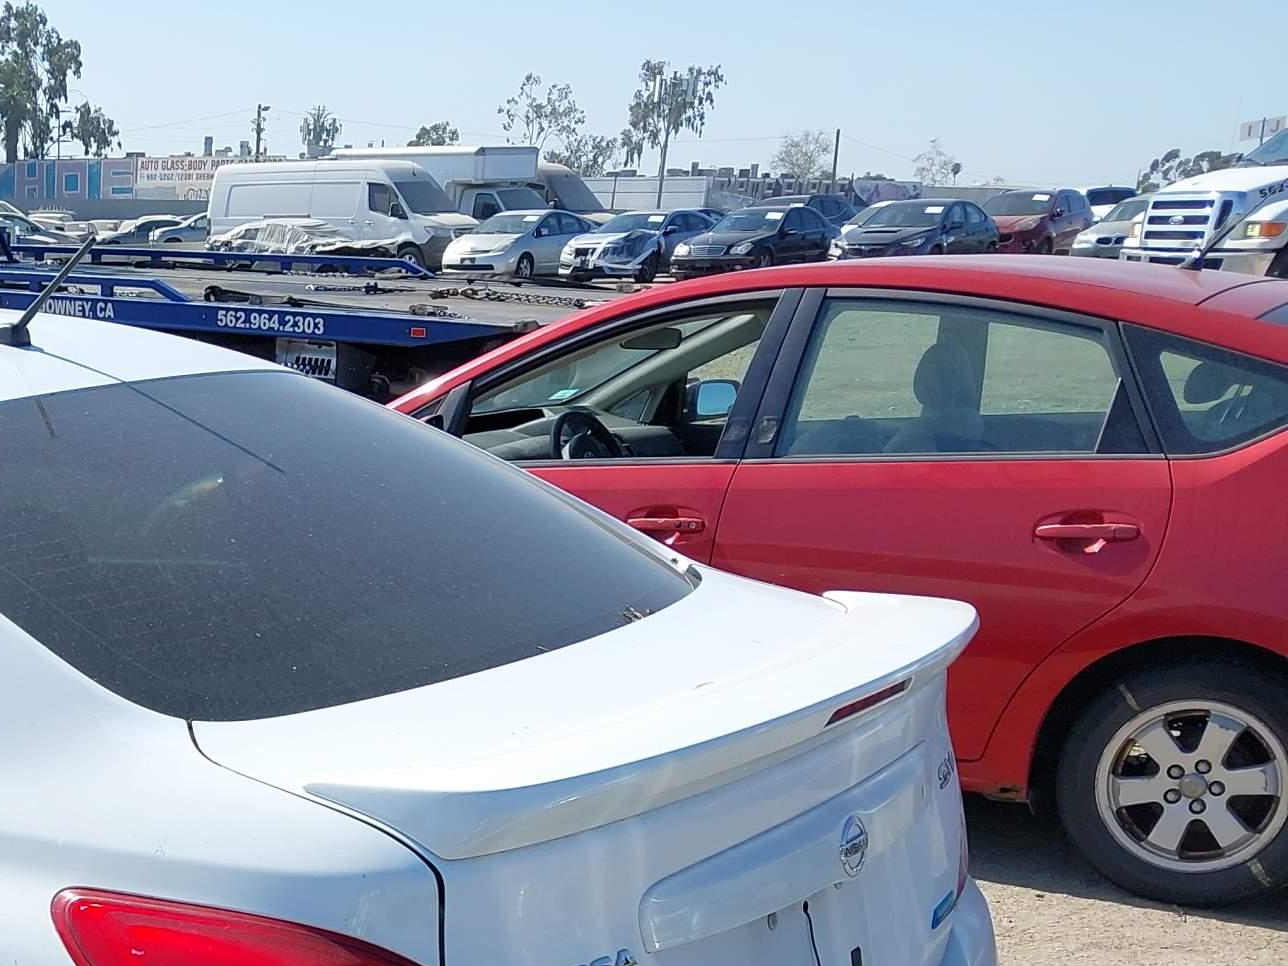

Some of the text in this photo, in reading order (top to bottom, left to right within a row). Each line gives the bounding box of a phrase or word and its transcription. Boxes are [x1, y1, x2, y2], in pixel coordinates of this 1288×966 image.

[140, 160, 159, 171] AUTO
[96, 302, 114, 319] CA
[216, 309, 324, 335] 562.964.2303
